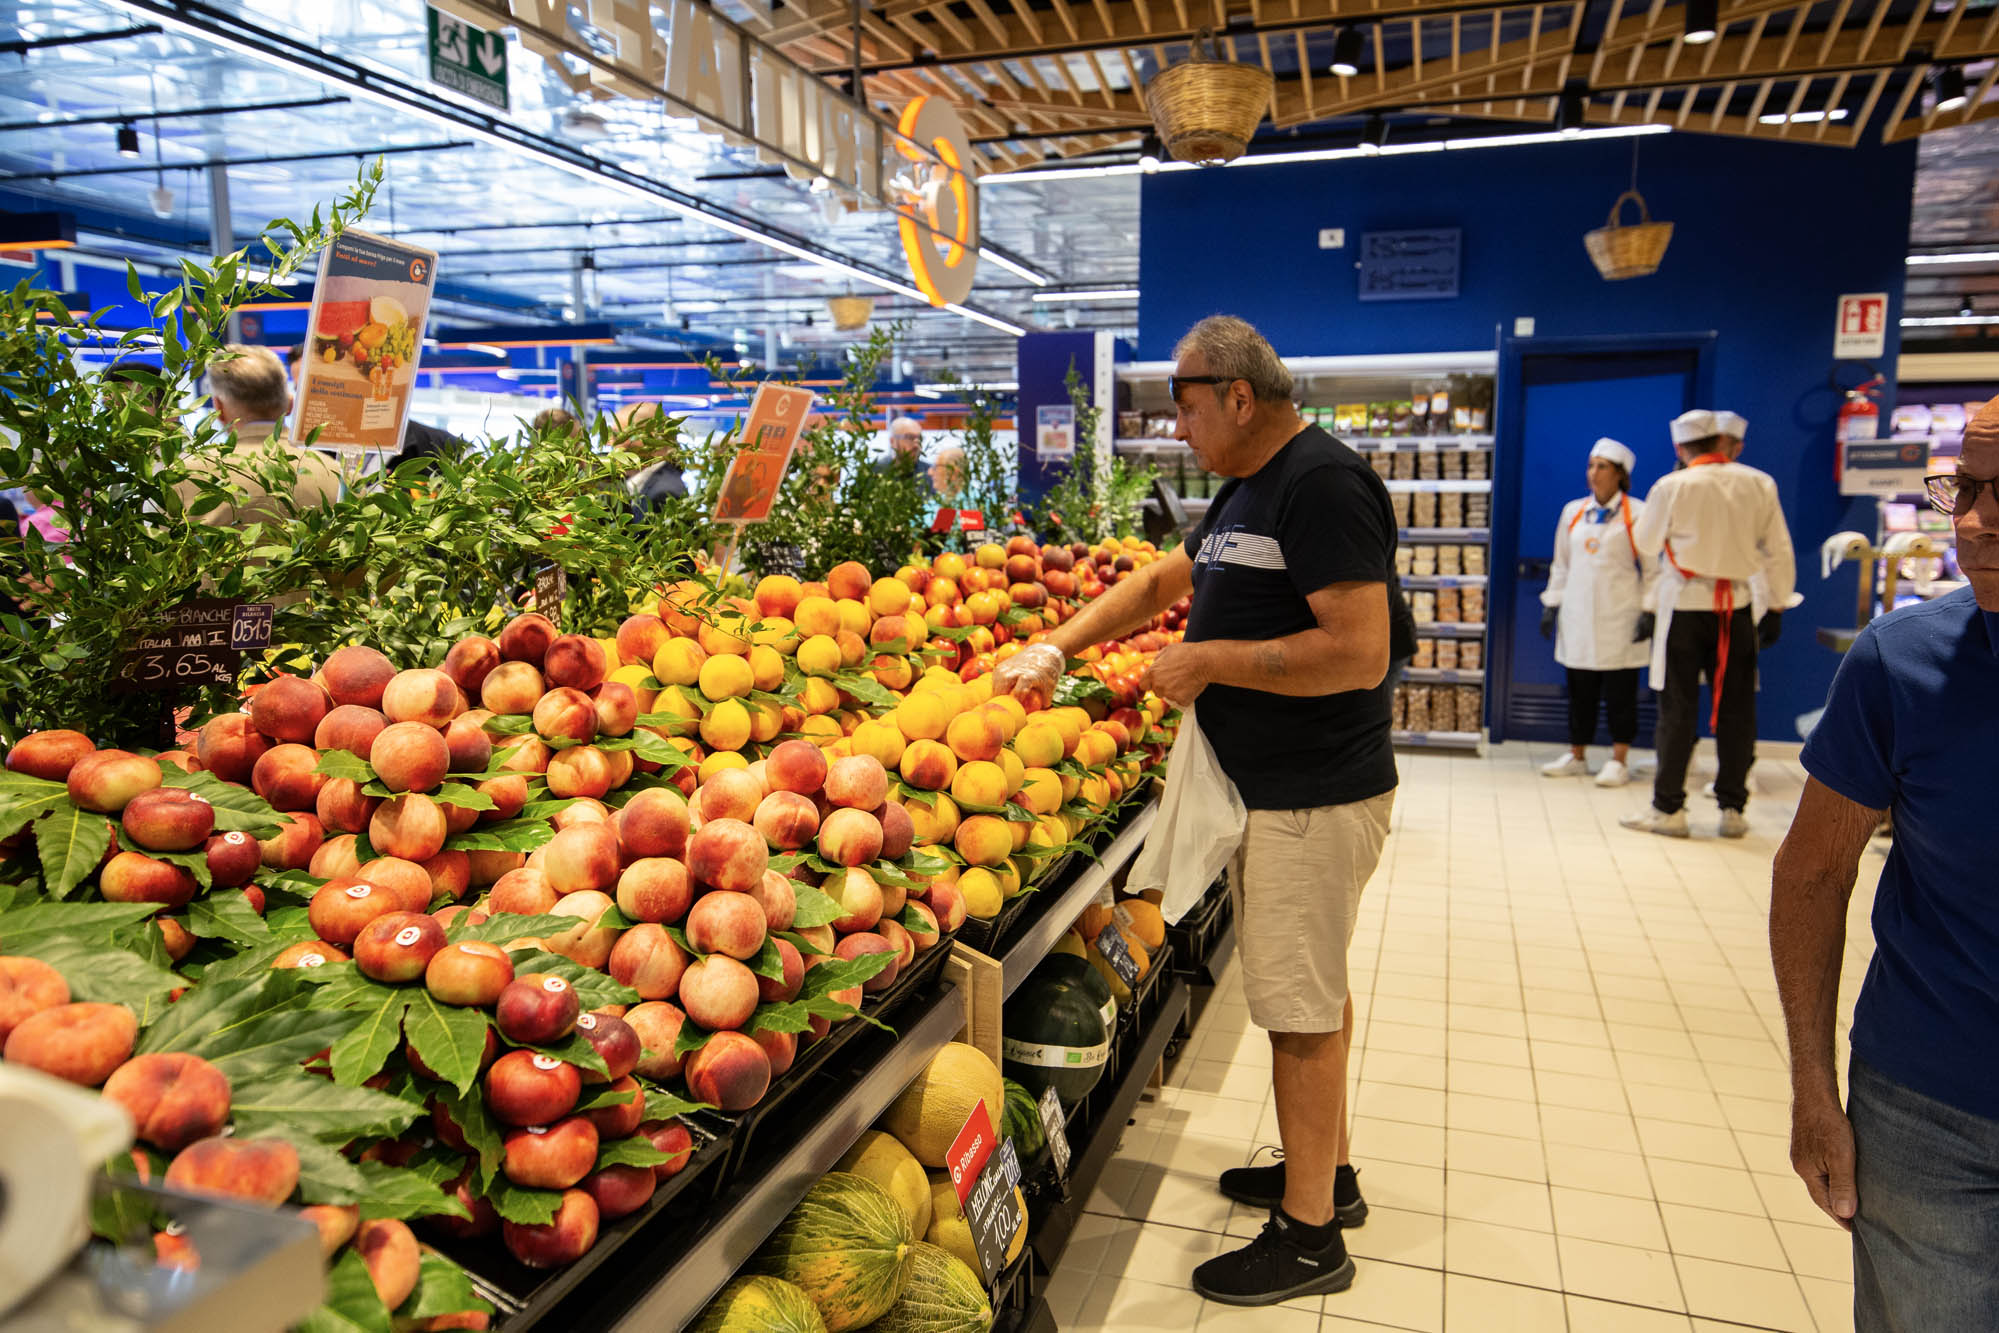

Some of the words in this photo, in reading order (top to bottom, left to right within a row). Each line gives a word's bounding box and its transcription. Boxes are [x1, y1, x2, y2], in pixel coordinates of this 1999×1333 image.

[179, 607, 232, 624] BIANCHE
[232, 617, 271, 642] 0515
[144, 653, 212, 680] 3,65
[960, 1133, 983, 1172] Ribasso
[971, 1167, 994, 1220] MELONE
